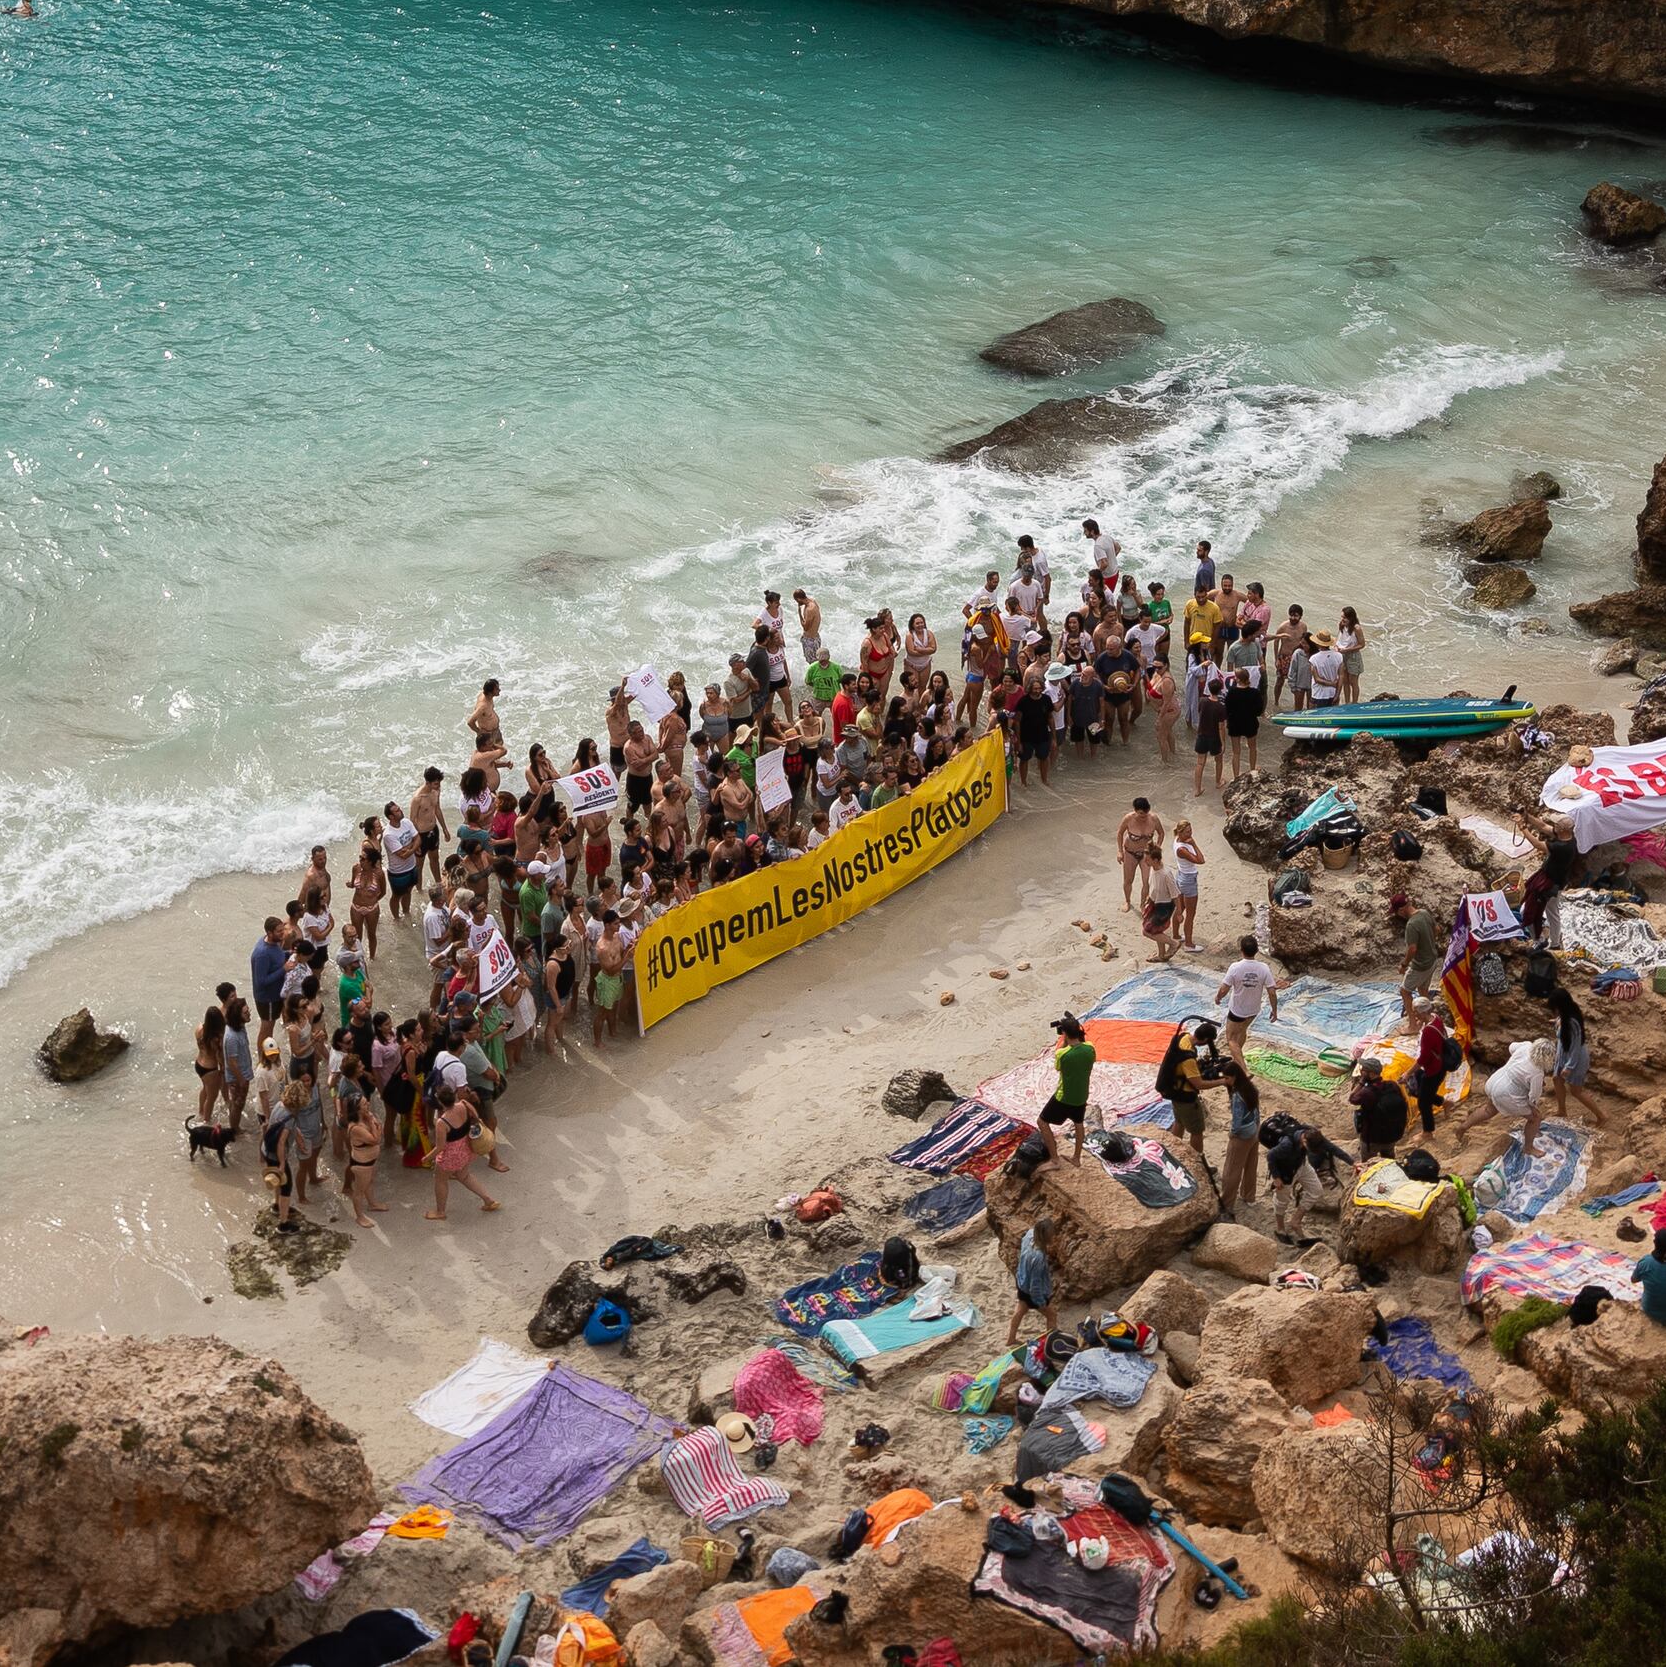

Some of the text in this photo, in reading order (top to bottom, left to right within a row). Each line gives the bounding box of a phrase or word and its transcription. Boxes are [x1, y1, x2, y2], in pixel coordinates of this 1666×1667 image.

[769, 653, 785, 665] SOS
[640, 672, 653, 686] SOS
[573, 768, 612, 794] SOS
[646, 770, 993, 993] #OcupemLesNostresPlatges
[476, 928, 494, 942] SOS
[489, 938, 510, 975] SOS
